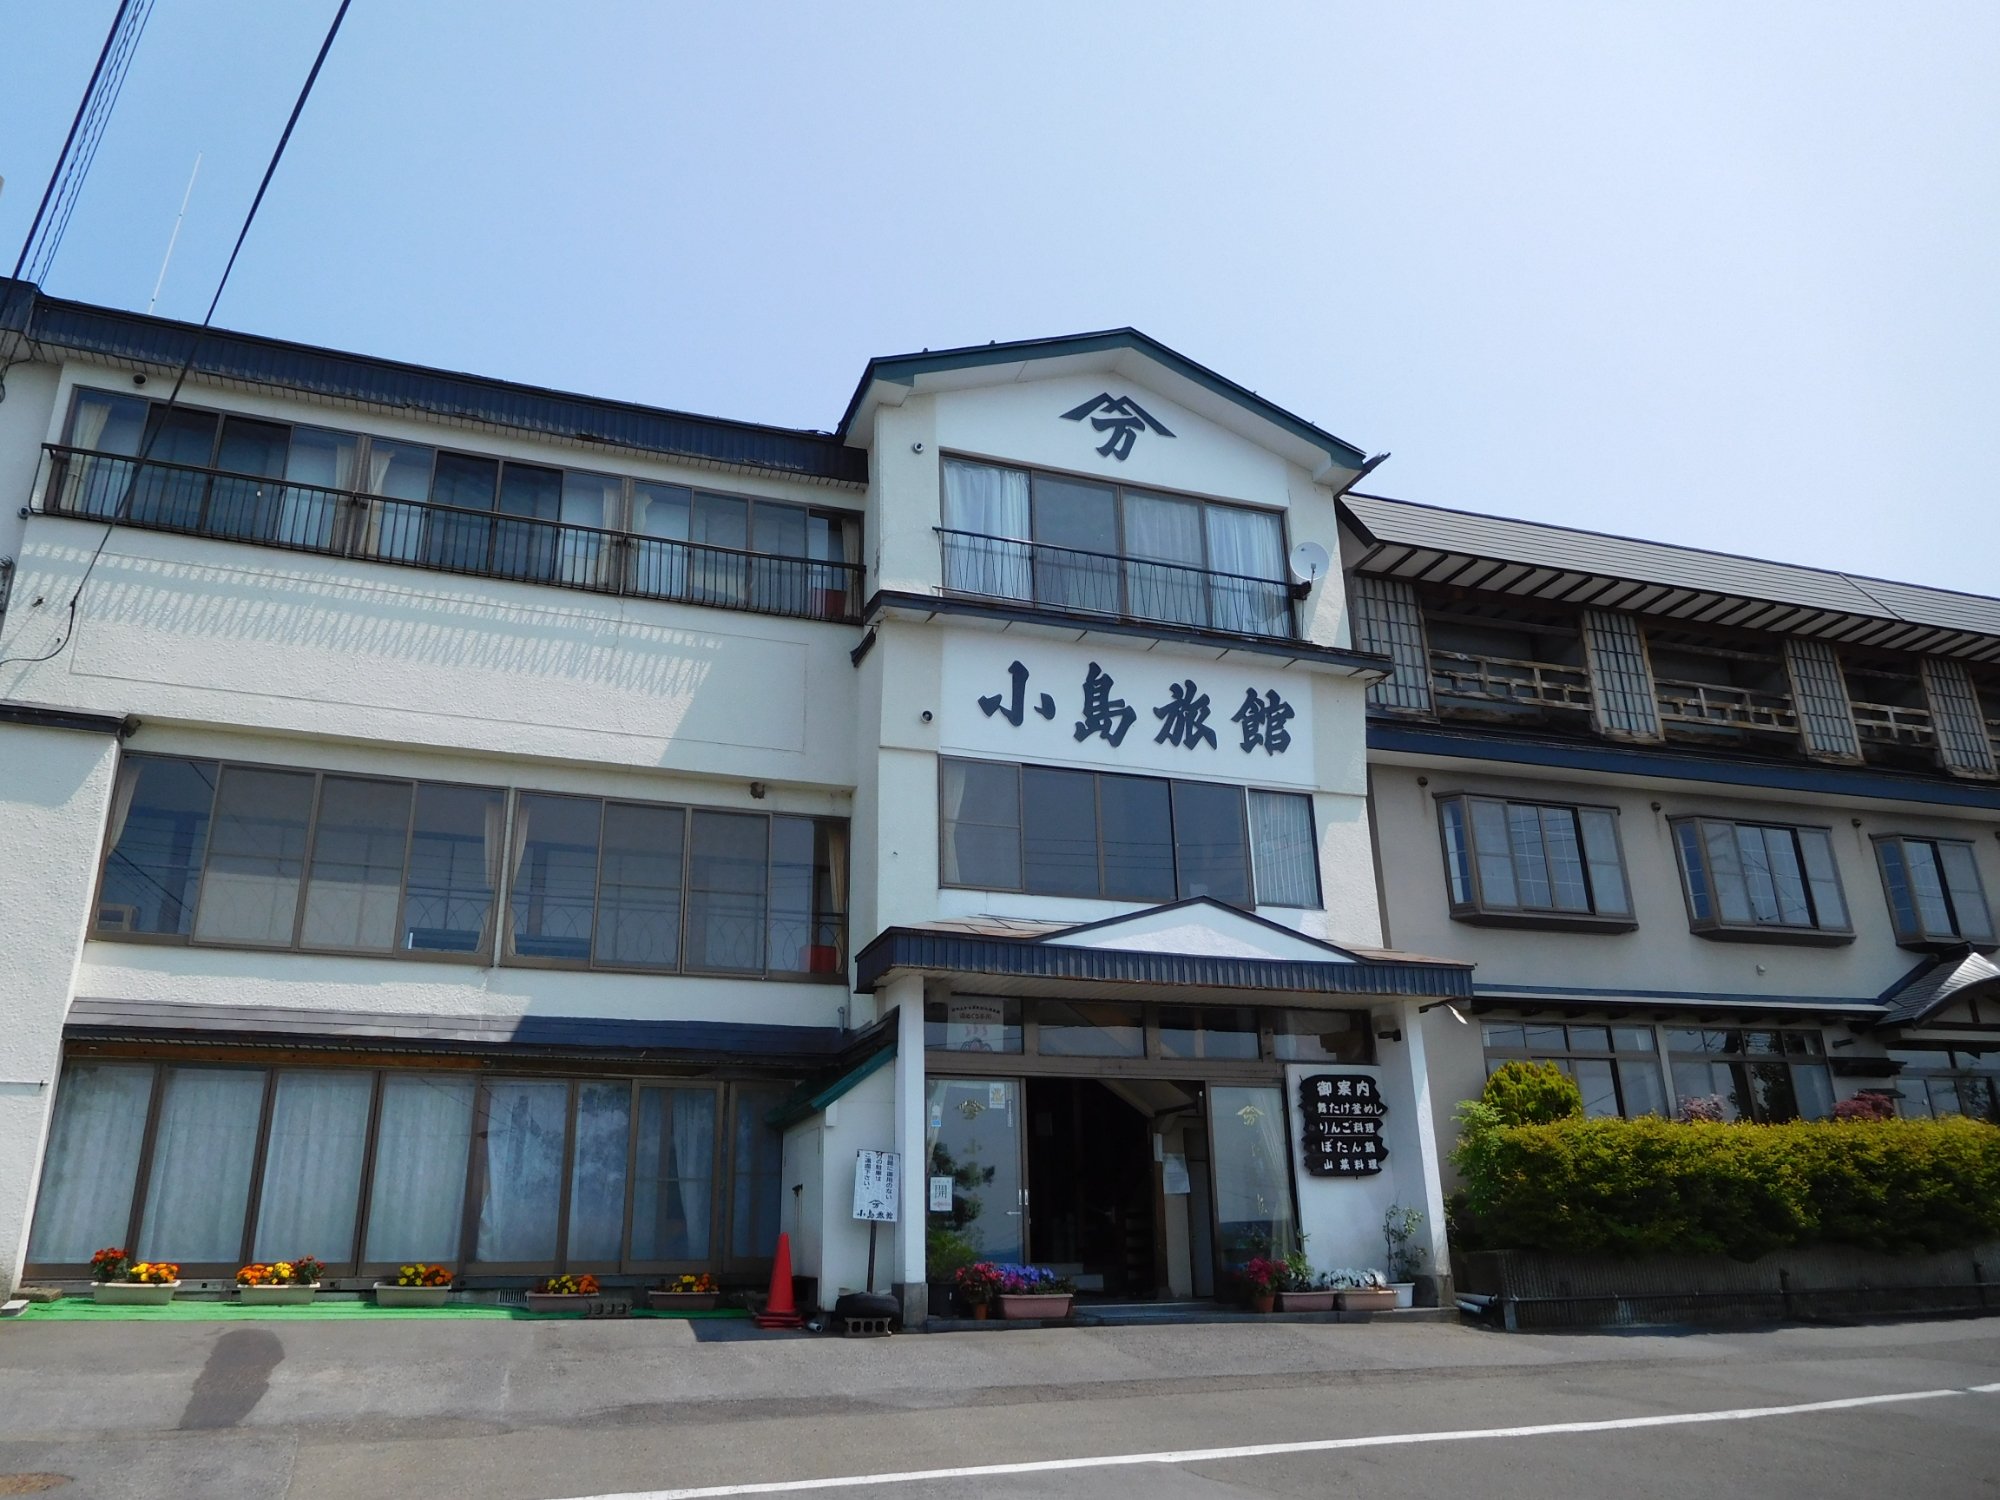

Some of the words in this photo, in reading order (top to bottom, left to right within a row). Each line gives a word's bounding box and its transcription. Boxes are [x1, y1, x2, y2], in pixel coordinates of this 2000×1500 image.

[977, 659, 1296, 756] 小島旅館
[1316, 1080, 1370, 1097] 御案内
[1319, 1120, 1376, 1134] りんご料理
[1323, 1158, 1379, 1171] 山菜料理
